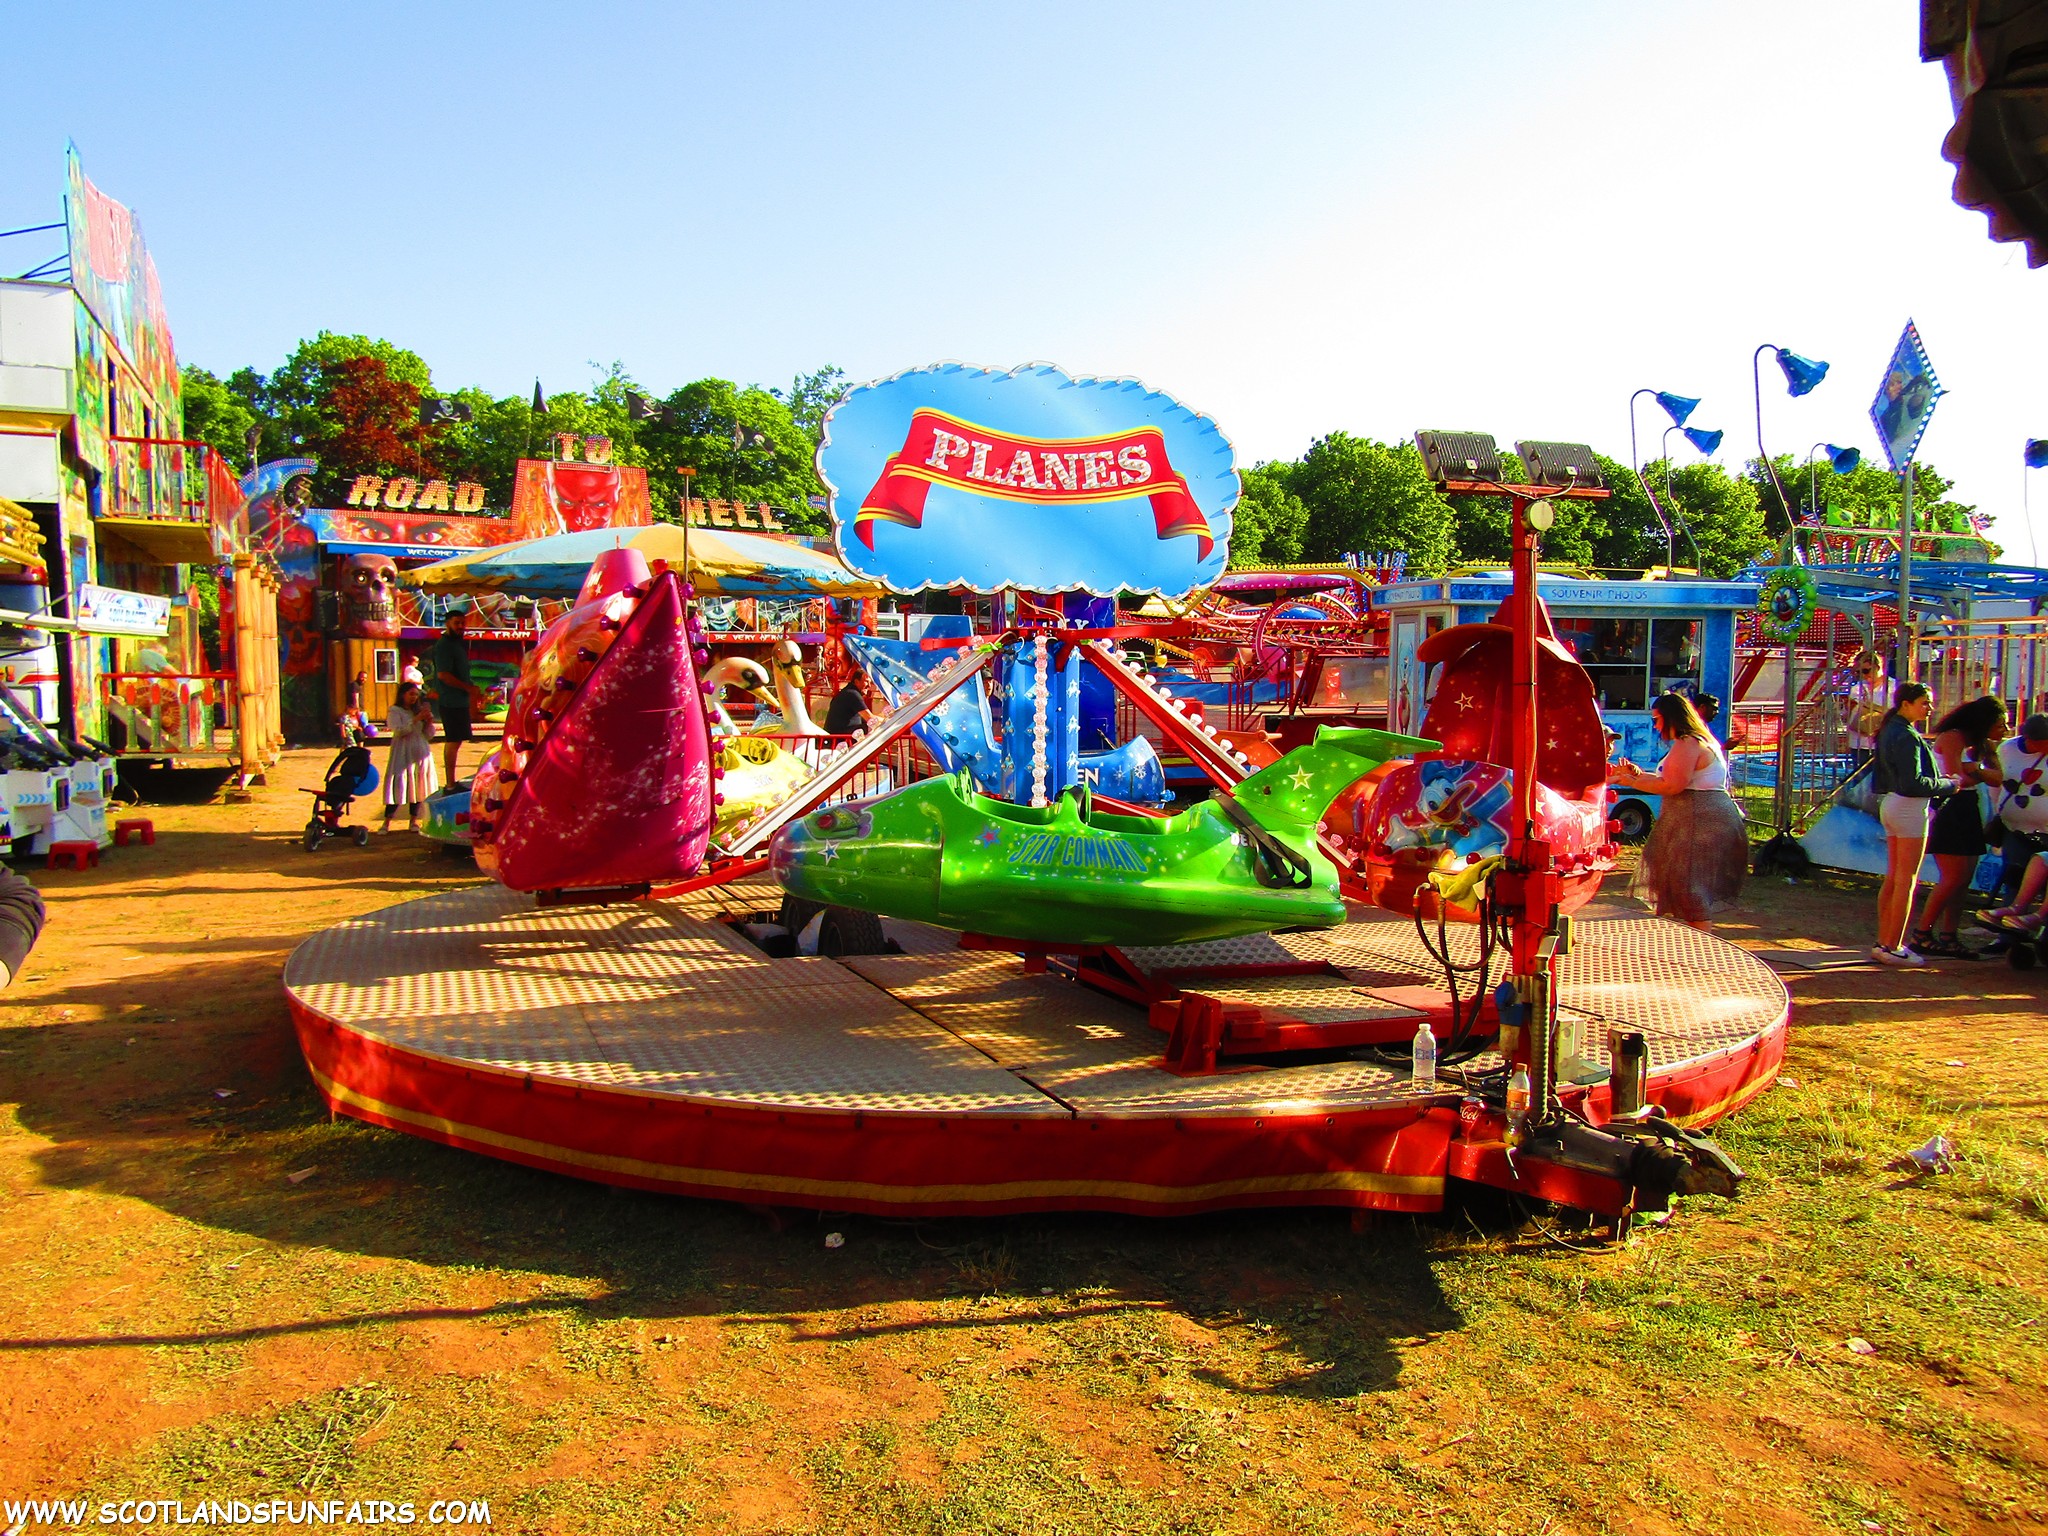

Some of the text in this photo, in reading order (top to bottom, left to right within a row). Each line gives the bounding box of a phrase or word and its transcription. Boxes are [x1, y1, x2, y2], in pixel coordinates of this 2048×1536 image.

[556, 432, 612, 464] TO
[925, 427, 1152, 490] PLANES
[347, 474, 486, 512] ROAD
[679, 497, 784, 530] HELL
[406, 547, 452, 557] WELCOME
[1551, 588, 1648, 600] SOUVENIR PHOTOS
[492, 630, 531, 638] TRAIN
[732, 633, 756, 641] VERY
[1007, 833, 1148, 873] STAR COMMAND
